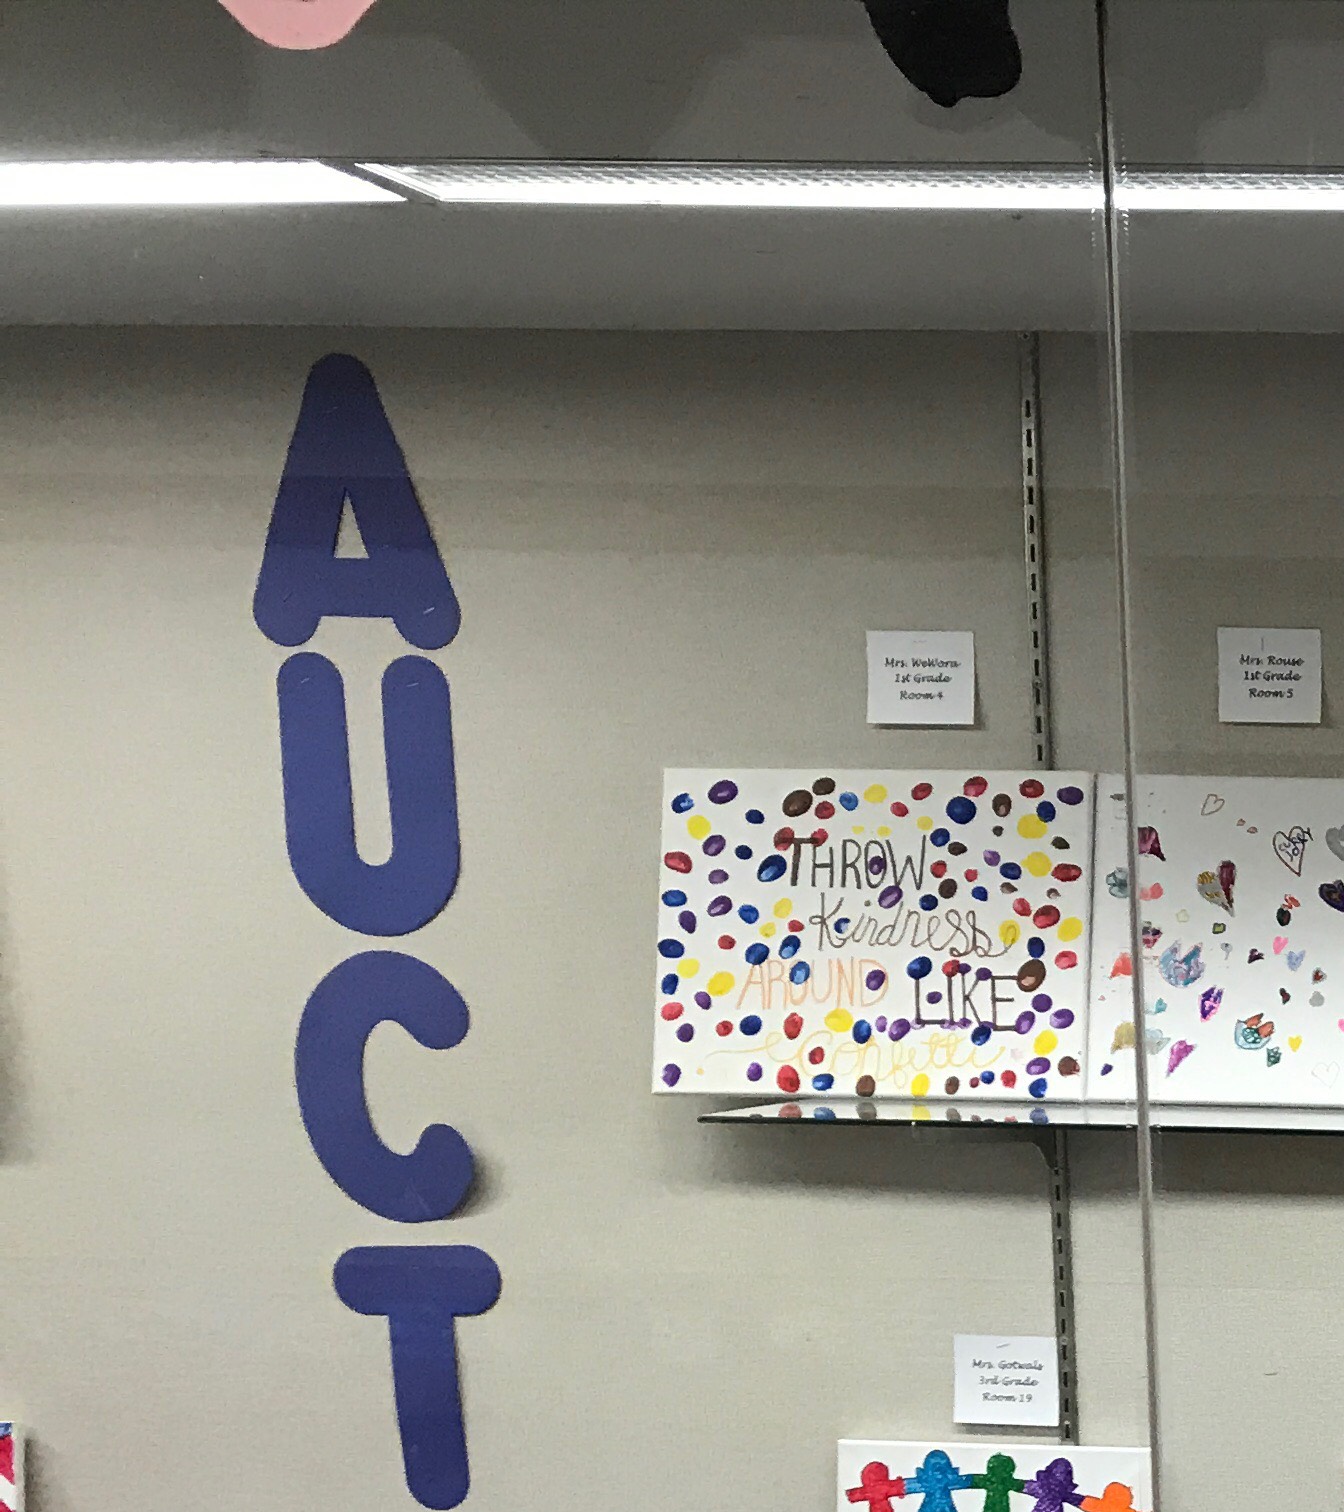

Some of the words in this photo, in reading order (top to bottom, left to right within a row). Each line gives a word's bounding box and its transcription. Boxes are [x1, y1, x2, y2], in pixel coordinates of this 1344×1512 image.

[1267, 655, 1305, 666] Rouse
[895, 673, 911, 684] 1st
[913, 673, 952, 684] Grade
[1243, 670, 1261, 681] 1st
[1262, 670, 1302, 682] Grade
[899, 690, 935, 700] Room
[1248, 688, 1284, 699] Room
[1285, 688, 1294, 699] 5
[786, 836, 927, 890] THROW
[809, 892, 1016, 957] Kindness
[736, 957, 889, 1010] AROUND
[914, 966, 1018, 1032] LIKE
[979, 1374, 1000, 1386] 3rd
[1001, 1374, 1039, 1387] Grade
[982, 1391, 1016, 1402] Room
[1018, 1391, 1033, 1403] 19
